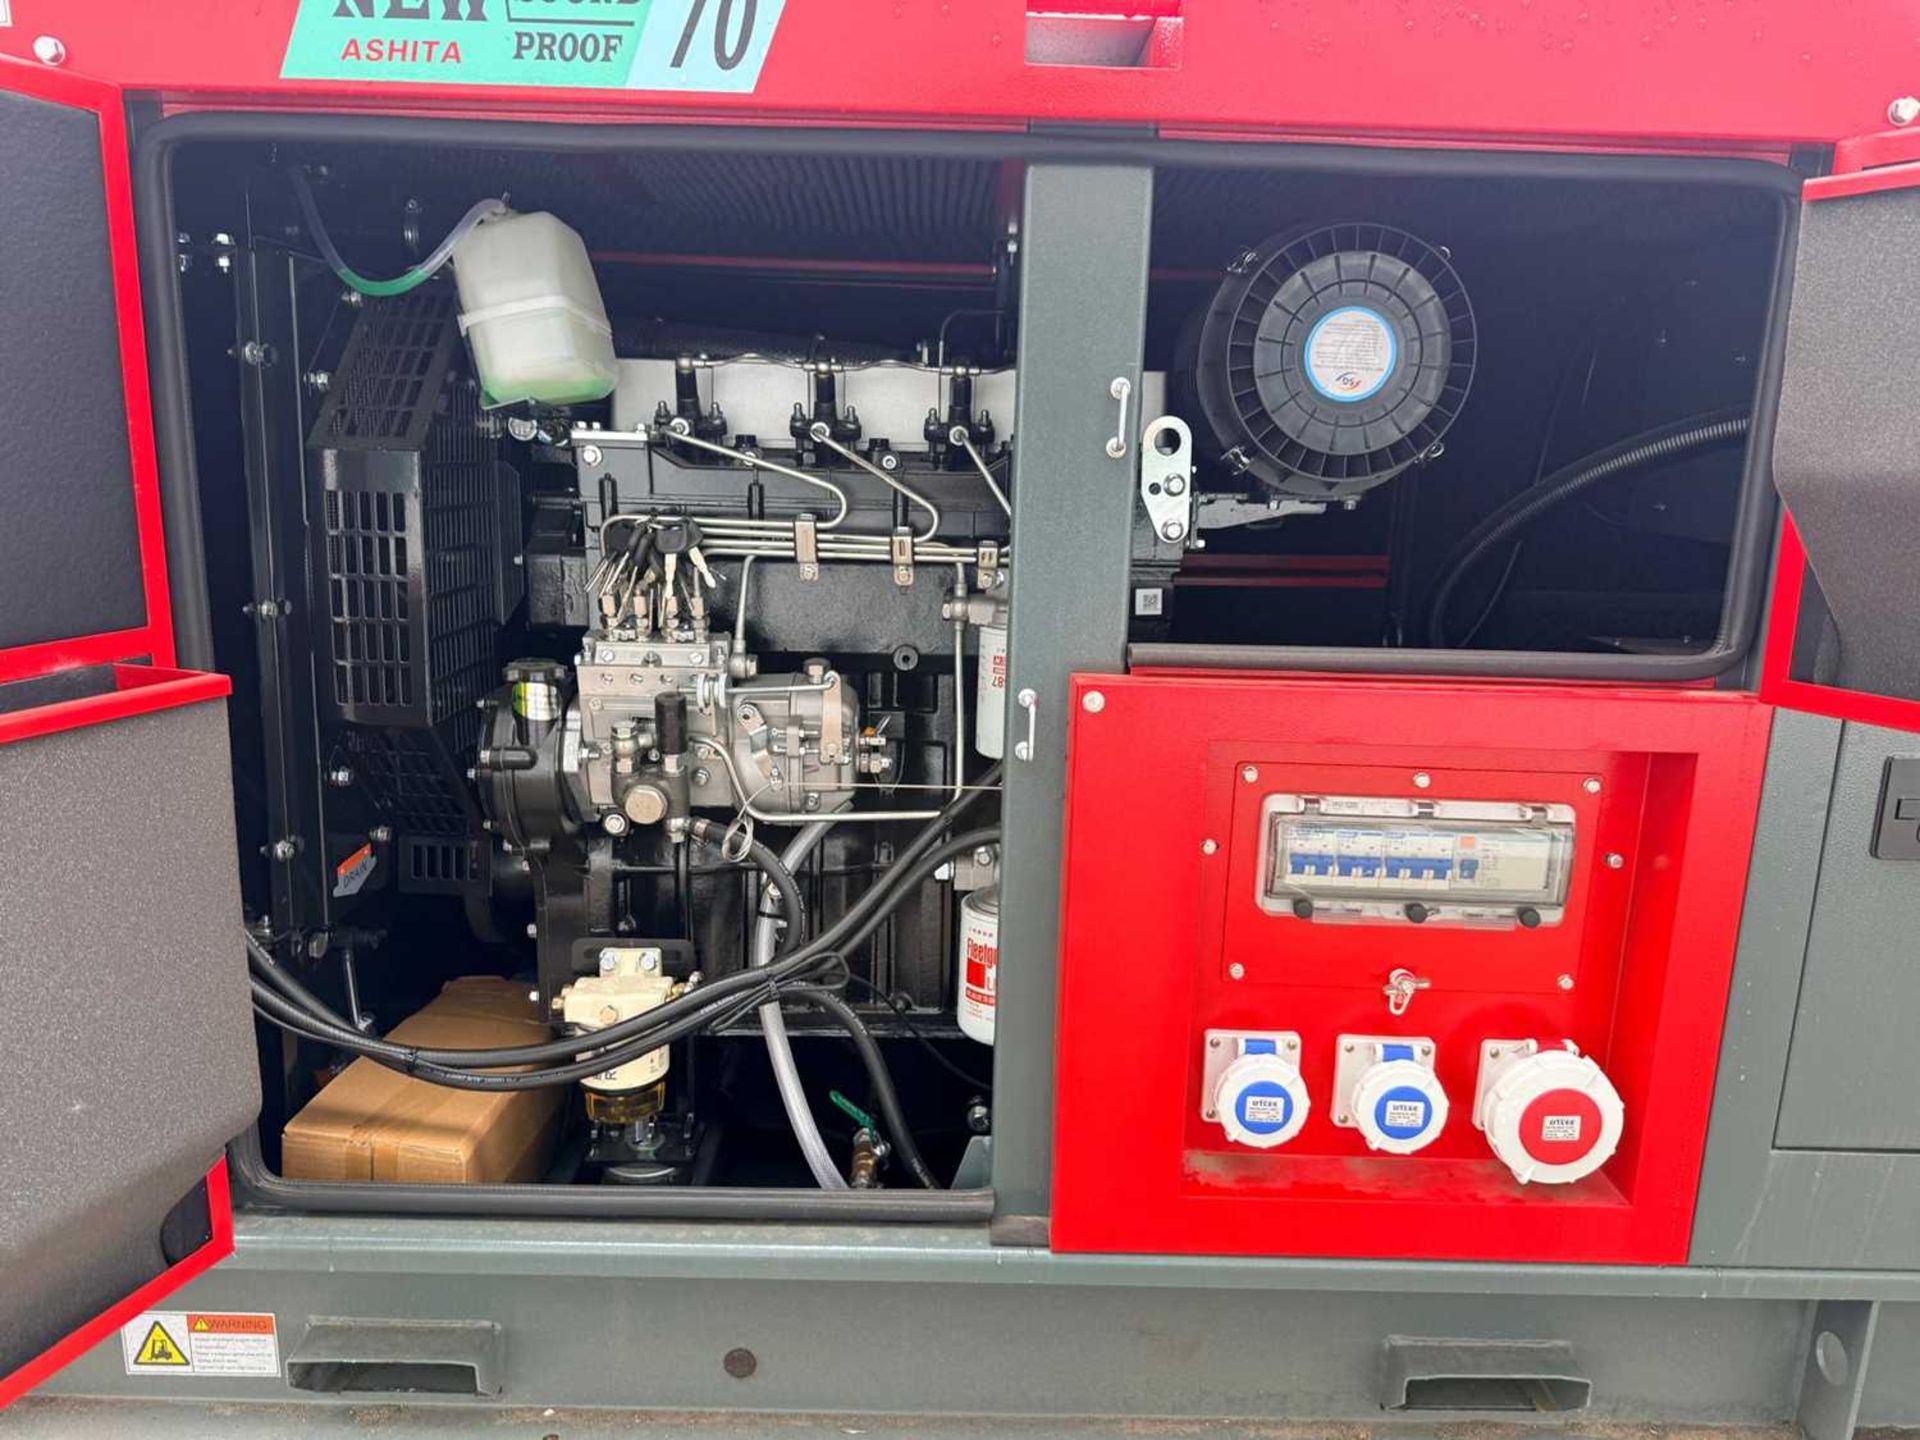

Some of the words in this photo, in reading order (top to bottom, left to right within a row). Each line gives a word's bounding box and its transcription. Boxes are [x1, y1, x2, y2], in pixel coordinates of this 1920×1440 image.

[340, 38, 462, 64] ASHITA
[512, 31, 623, 63] PROOF
[208, 1318, 268, 1330] WARNING
